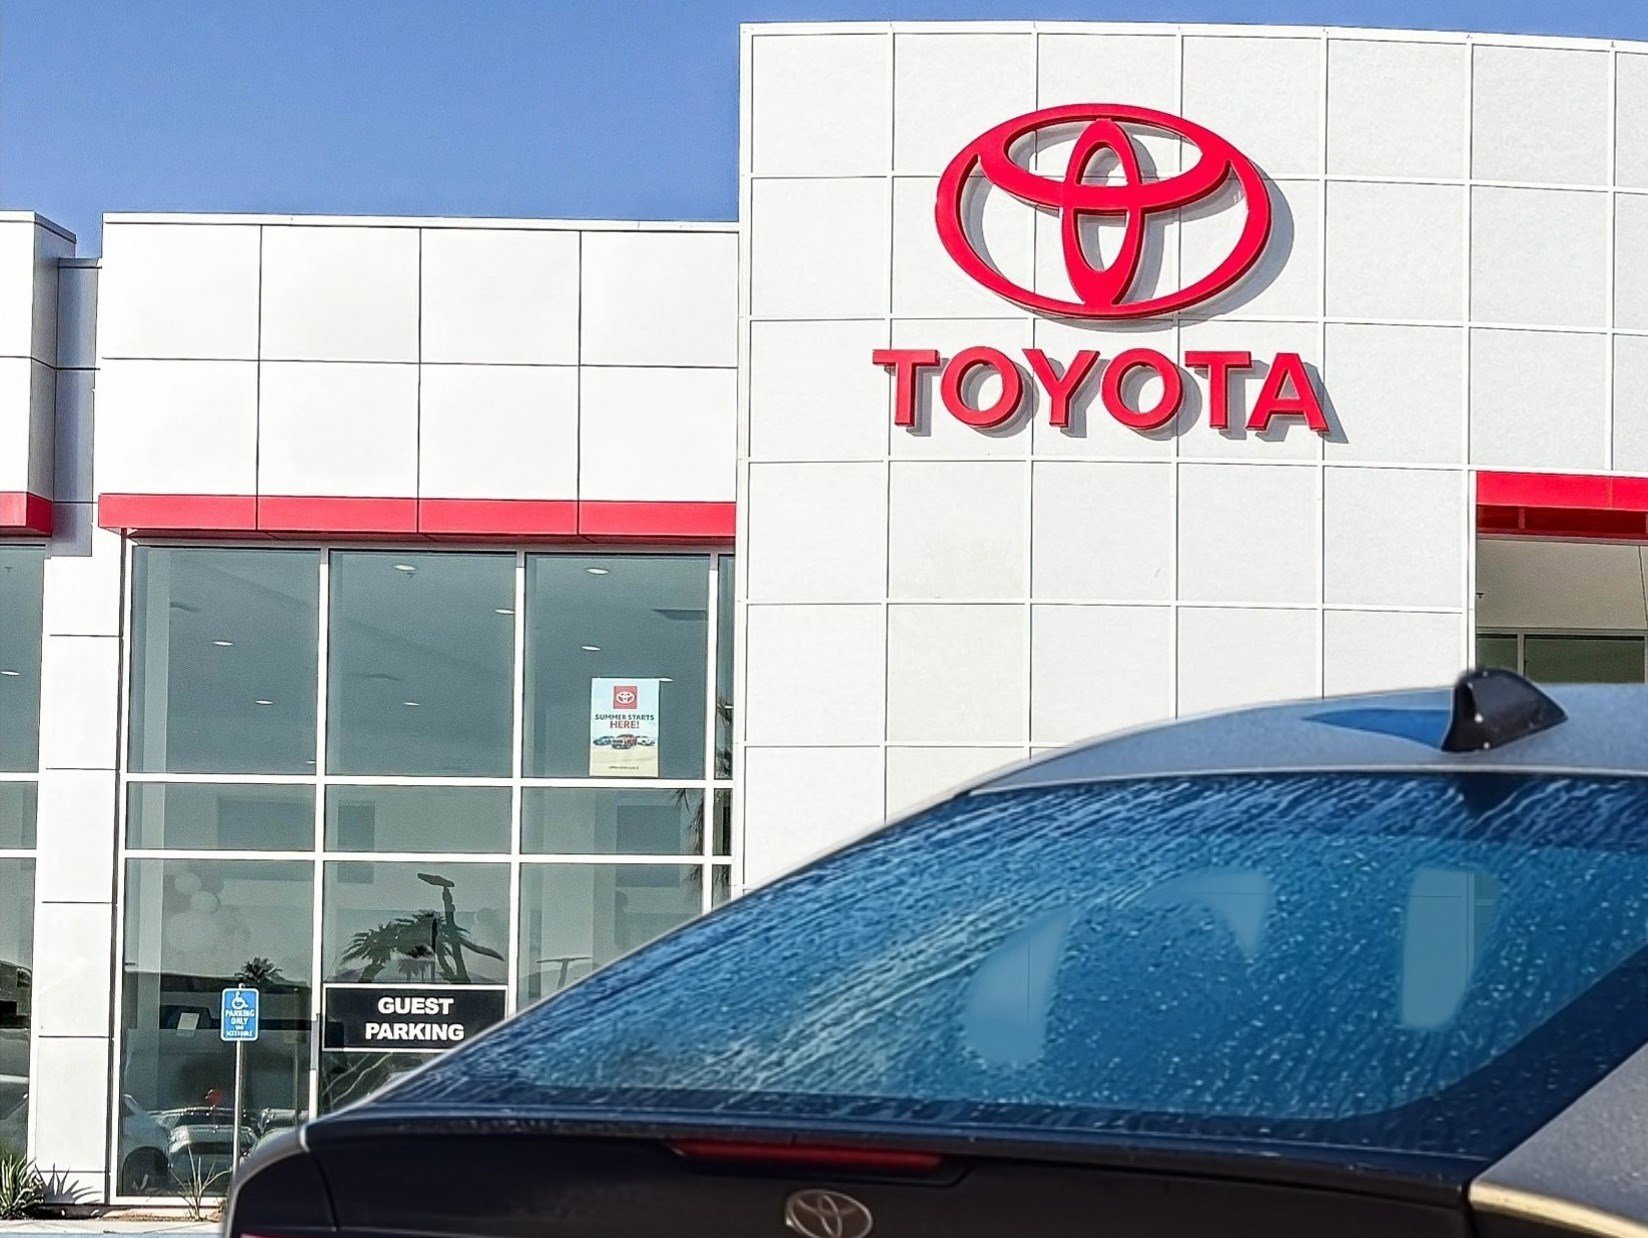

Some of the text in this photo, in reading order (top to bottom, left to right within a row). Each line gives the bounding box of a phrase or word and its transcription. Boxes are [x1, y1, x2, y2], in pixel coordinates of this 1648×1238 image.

[872, 345, 1331, 434] TOYOTA
[609, 720, 640, 729] HERE!
[377, 996, 455, 1015] GUEST
[225, 1009, 255, 1017] PARKING
[230, 1017, 249, 1025] ONLY
[365, 1022, 465, 1041] PARKING
